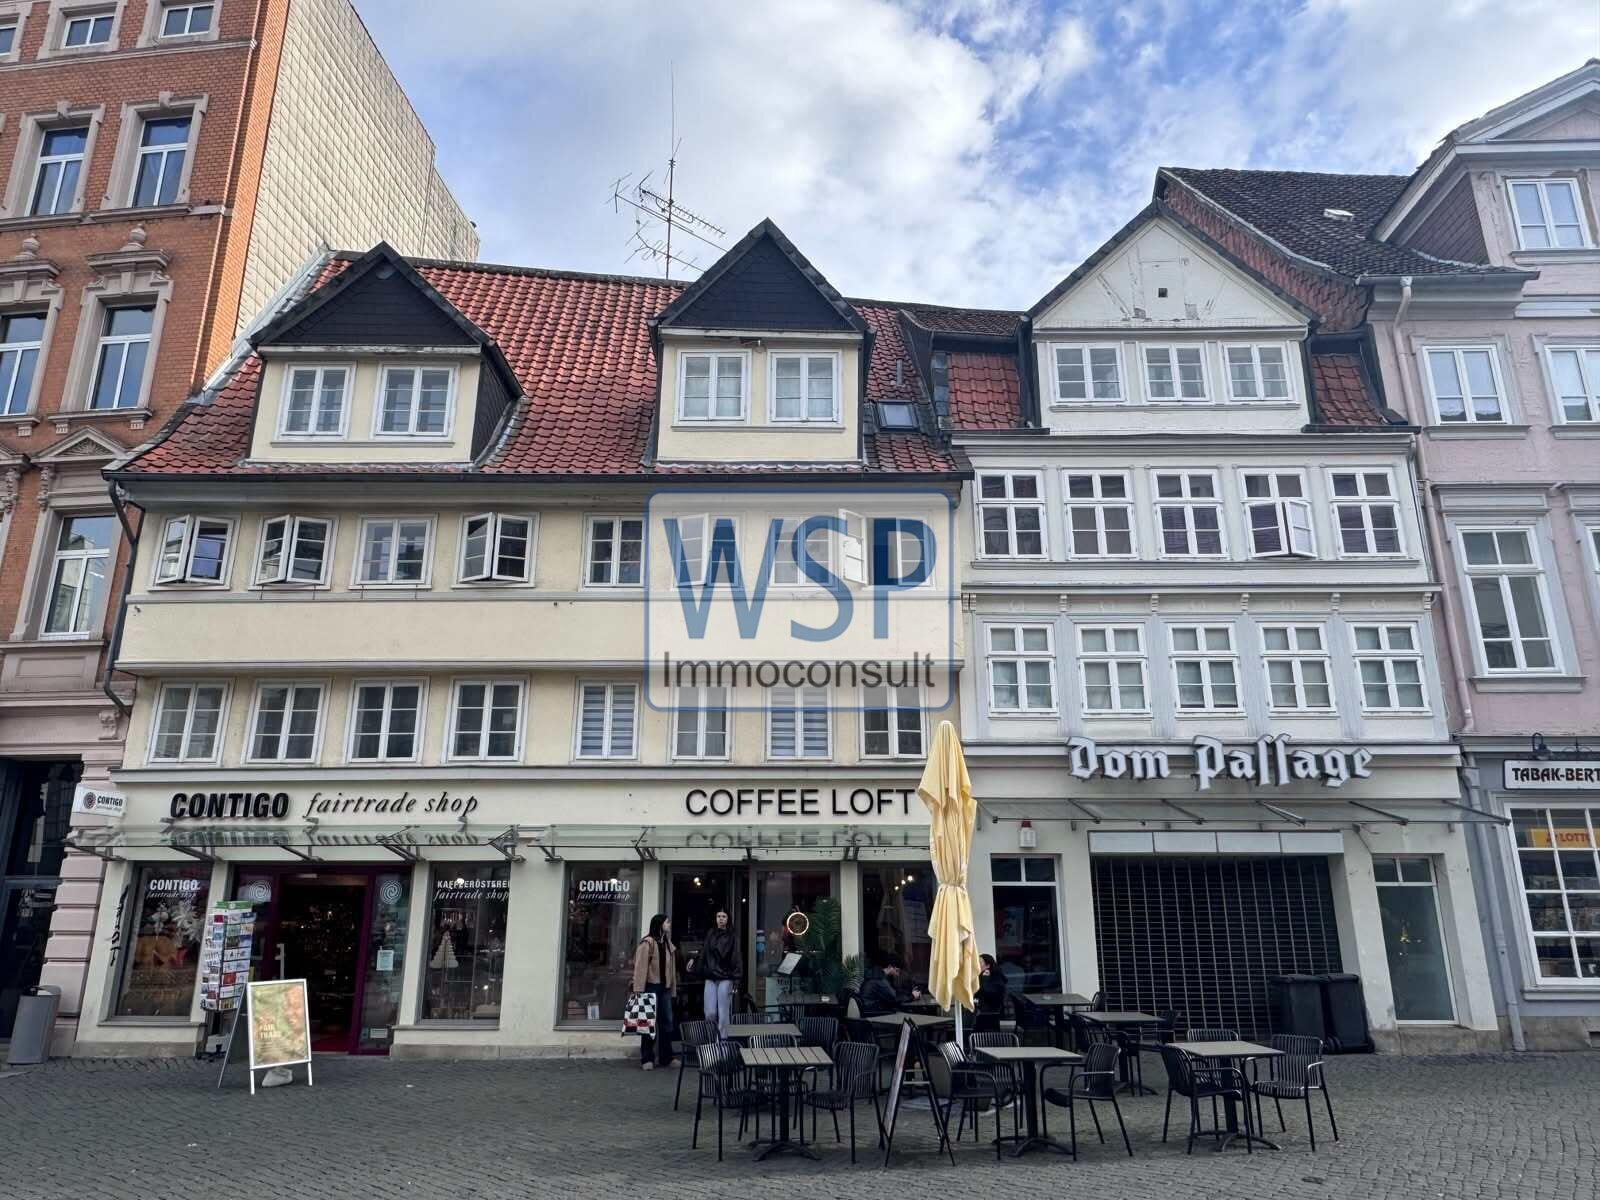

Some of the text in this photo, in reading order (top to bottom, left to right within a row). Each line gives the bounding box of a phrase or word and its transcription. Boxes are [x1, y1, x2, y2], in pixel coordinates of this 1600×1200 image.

[1066, 735, 1171, 780] Dom
[97, 795, 123, 807] CONTIGO
[170, 791, 479, 820] CONTIGO fairtrade shop
[685, 788, 916, 816] COFFEE LOFT
[149, 879, 199, 891] CONTIGO
[579, 879, 630, 892] CONTIGO
